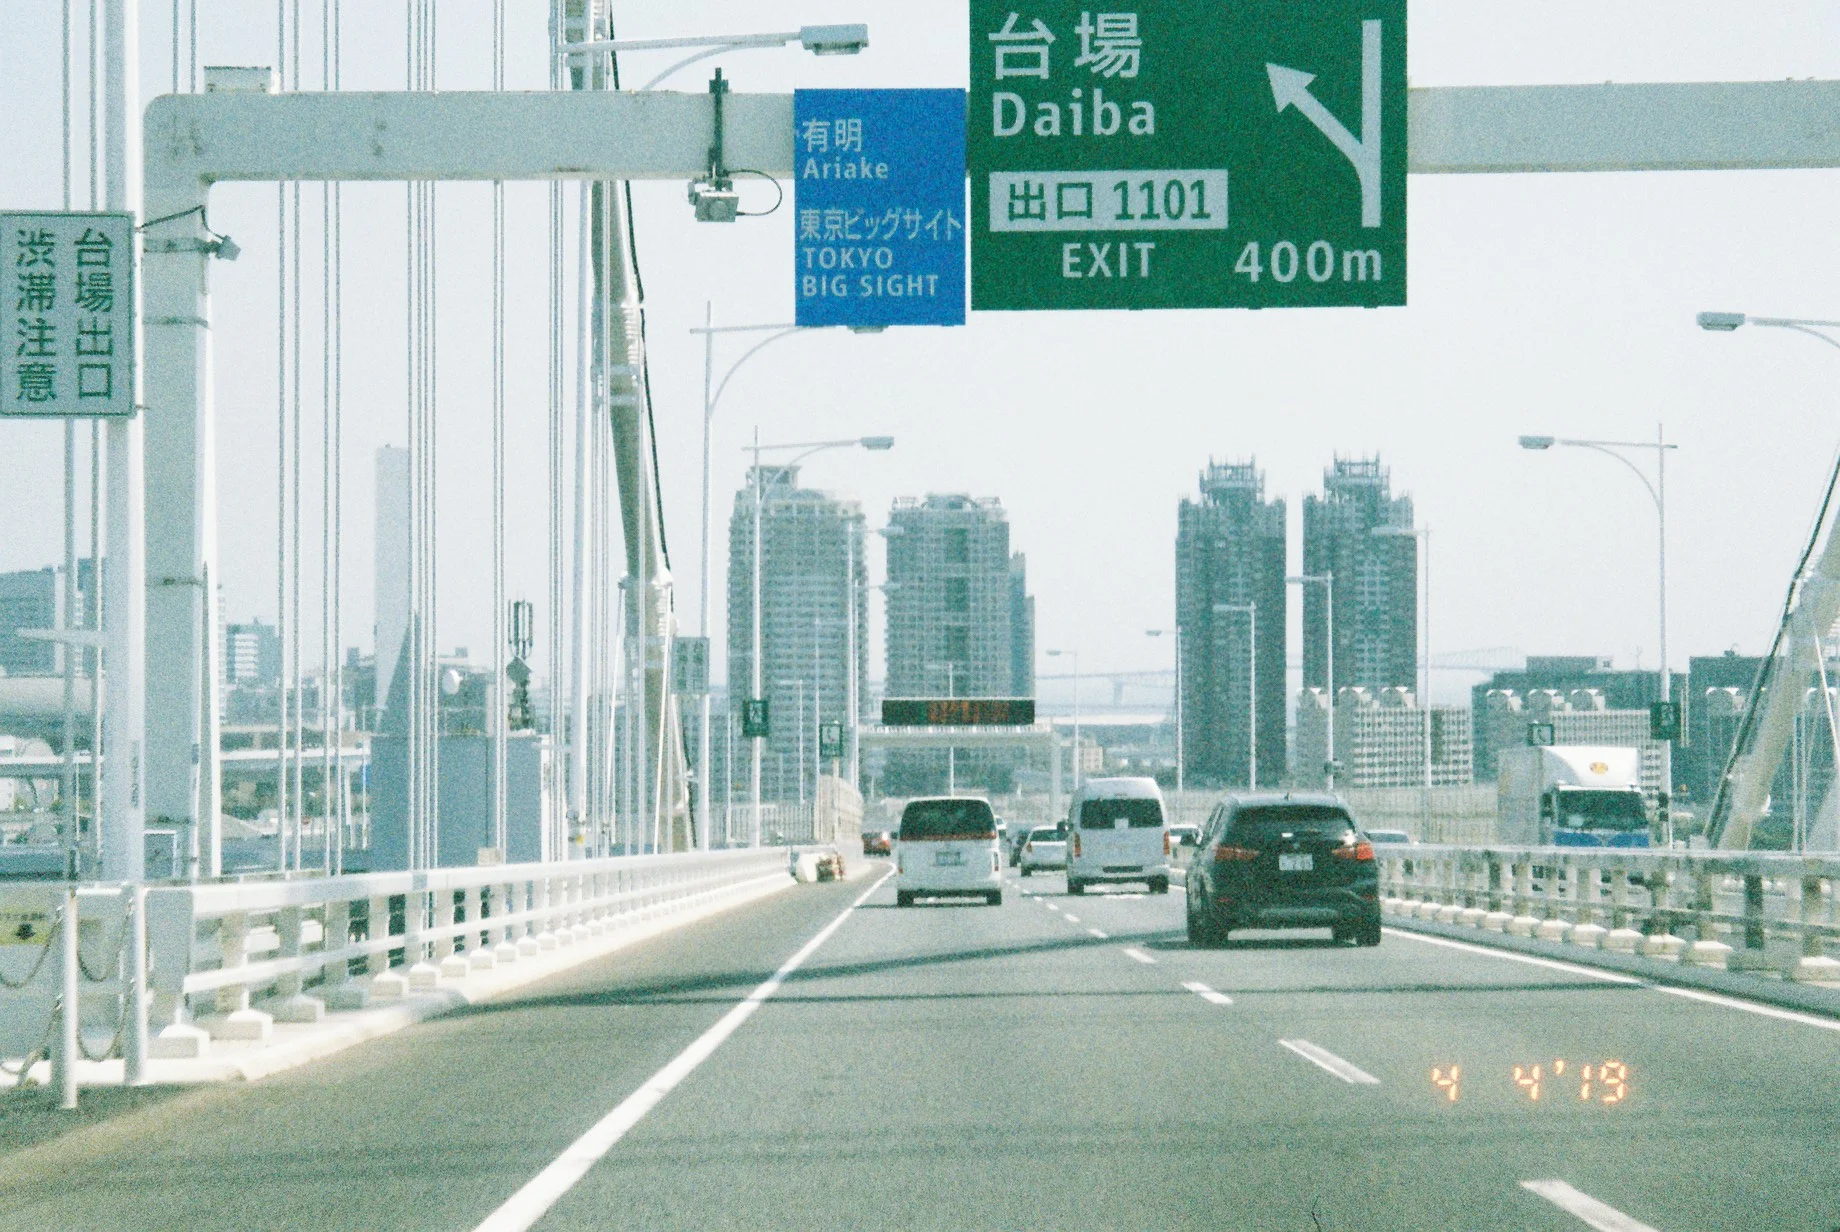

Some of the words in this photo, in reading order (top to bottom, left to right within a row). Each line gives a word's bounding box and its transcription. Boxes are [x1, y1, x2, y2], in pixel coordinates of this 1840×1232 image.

[988, 11, 1142, 80] 台場
[992, 88, 1156, 137] Daiba
[802, 117, 862, 153] 有明
[803, 156, 889, 180] Ariake
[1007, 181, 1094, 222] 出口
[1113, 178, 1212, 221] 1101
[799, 207, 962, 241] 東京ビッグサイト
[803, 246, 893, 269] TOKYO
[1062, 242, 1156, 278] EXIT
[1234, 240, 1382, 283] 400m
[802, 274, 848, 298] BIG
[859, 274, 939, 298] SIGHT
[16, 228, 57, 402] 渋滞注意
[73, 227, 114, 400] 台場出口
